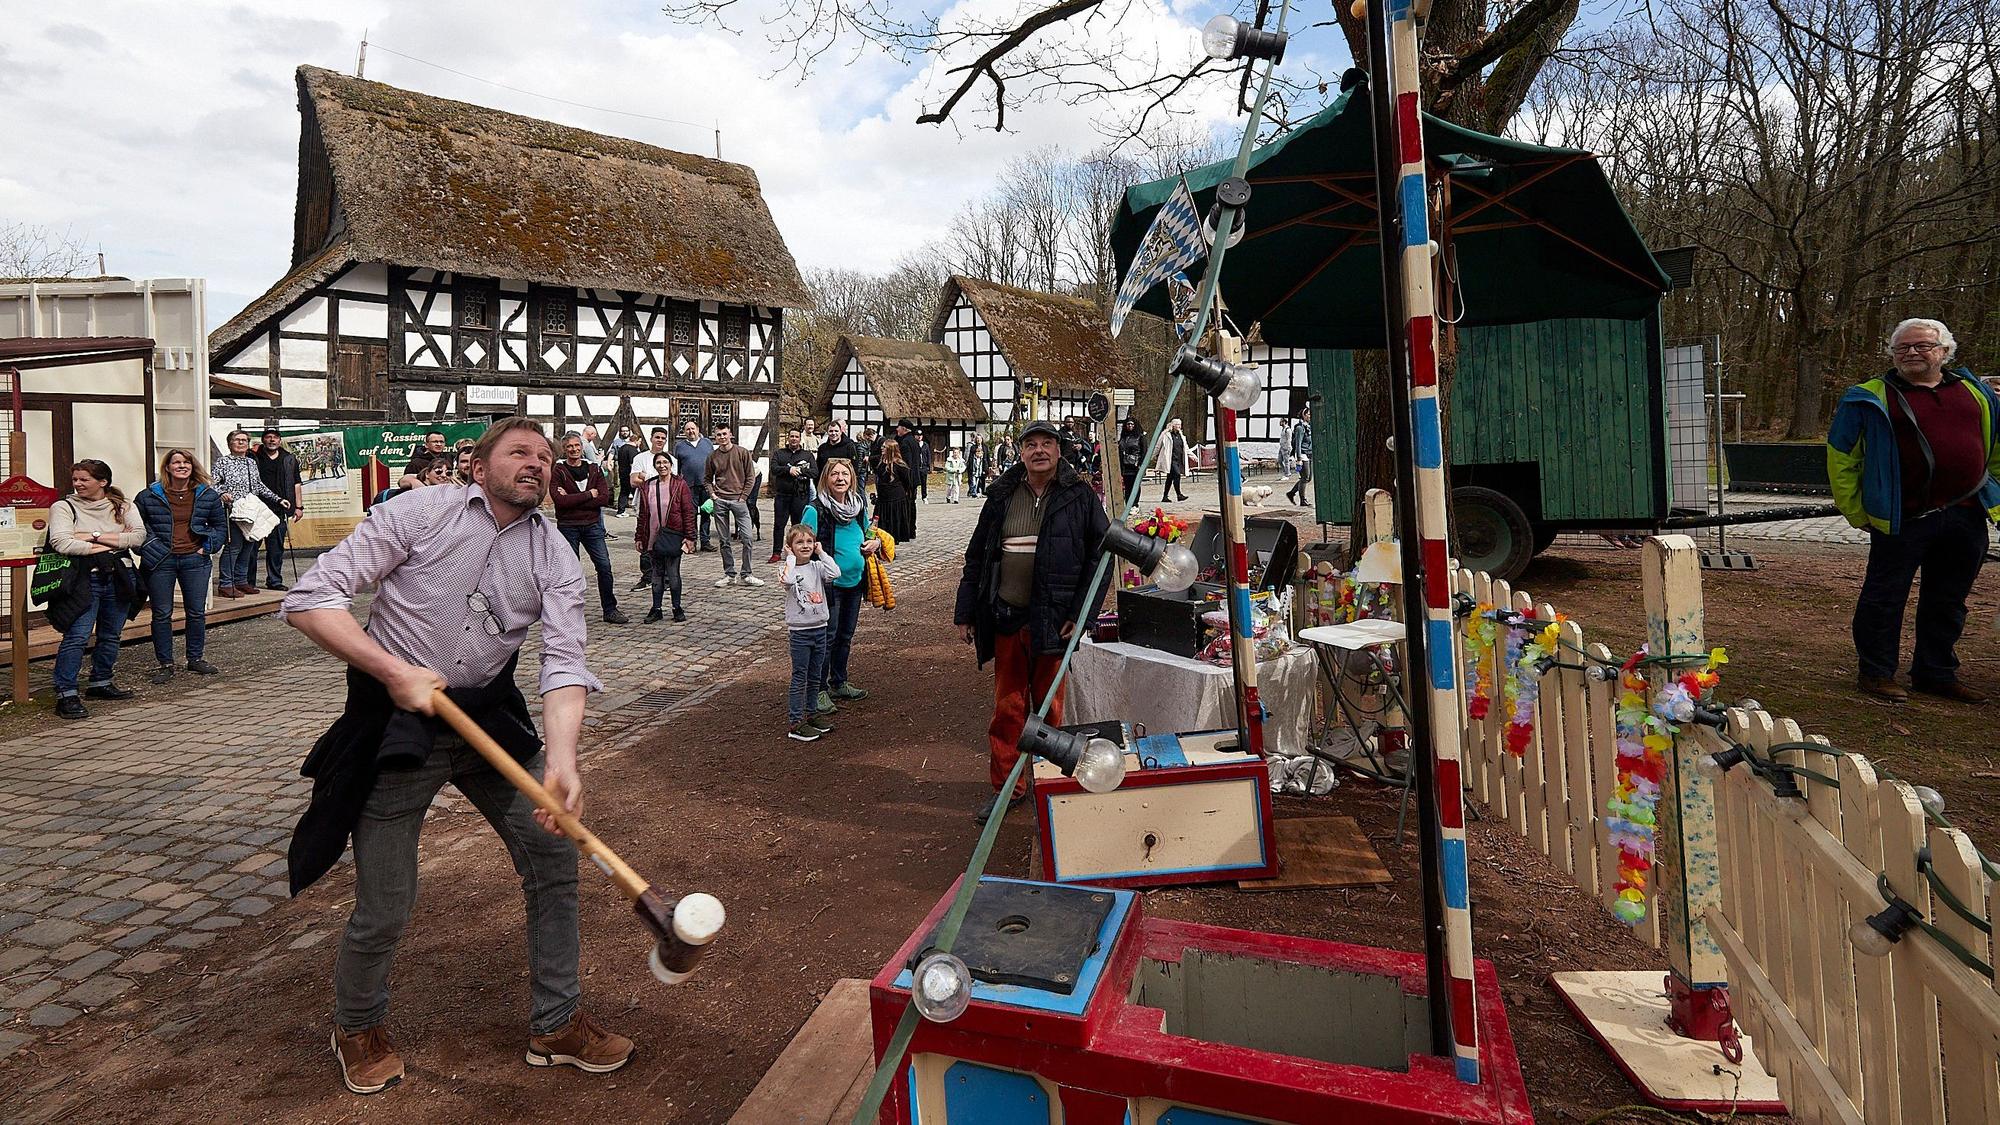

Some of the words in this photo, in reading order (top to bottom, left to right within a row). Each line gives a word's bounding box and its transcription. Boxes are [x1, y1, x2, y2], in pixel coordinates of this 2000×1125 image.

[470, 387, 515, 403] Handlung
[381, 431, 427, 443] Rassism
[359, 445, 380, 456] auf
[380, 444, 405, 457] dem
